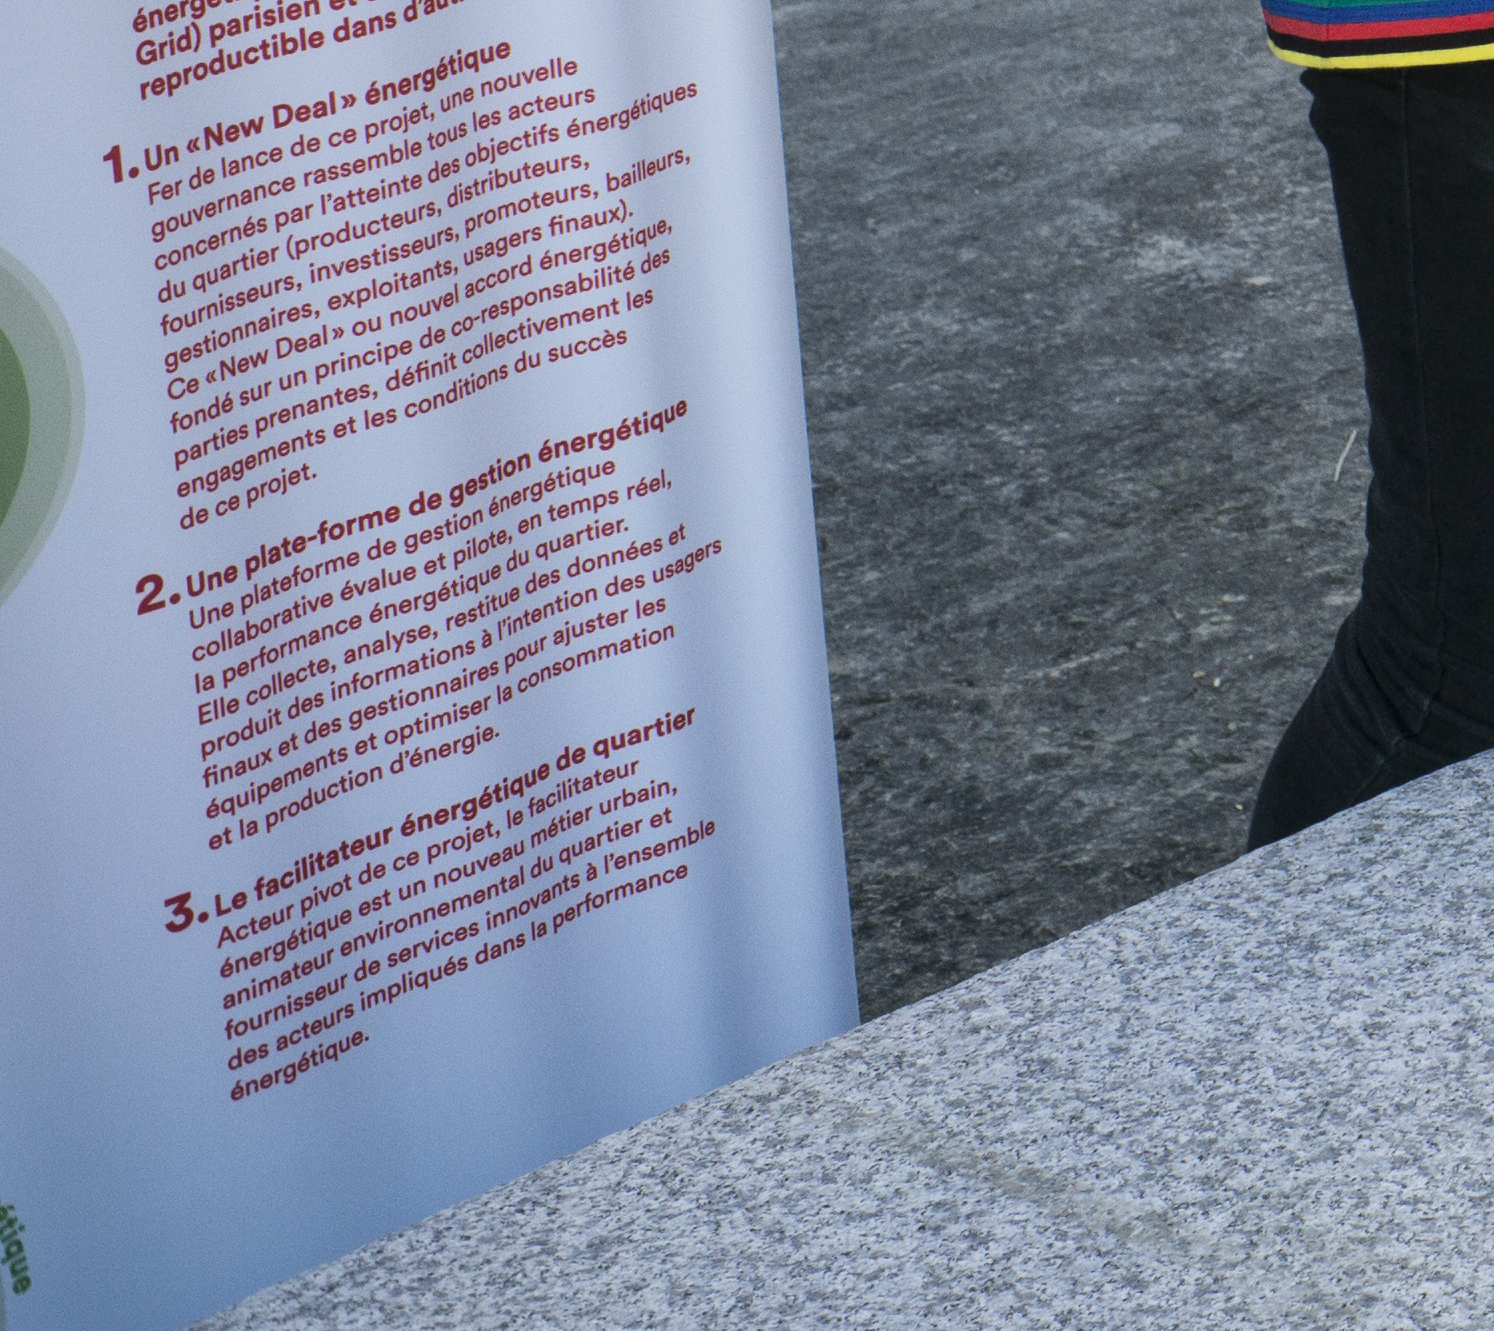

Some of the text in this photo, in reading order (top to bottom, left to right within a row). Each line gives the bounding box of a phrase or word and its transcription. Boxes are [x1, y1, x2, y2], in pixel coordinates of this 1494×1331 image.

[136, 22, 201, 65] Grid)
[209, 0, 320, 48] parisien
[140, 27, 325, 100] reproductible
[333, 11, 397, 43] dans
[103, 145, 139, 184] 1.
[144, 144, 179, 171] Un
[365, 42, 511, 105] énergétique
[148, 57, 577, 205] Fer de lance de ce projet, une nouvelle
[151, 89, 595, 243] gouvernance rassemble tous les acteurs
[154, 83, 697, 270] concernés par l'atteinte des objectifs énergétiques
[135, 400, 687, 615] 2. Une plate-forme de gestion énergétique
[164, 708, 695, 933] 3. Le facilitateur énergétique de quartier
[218, 761, 639, 948] Acteur pivot de ce projet, le facilitateur
